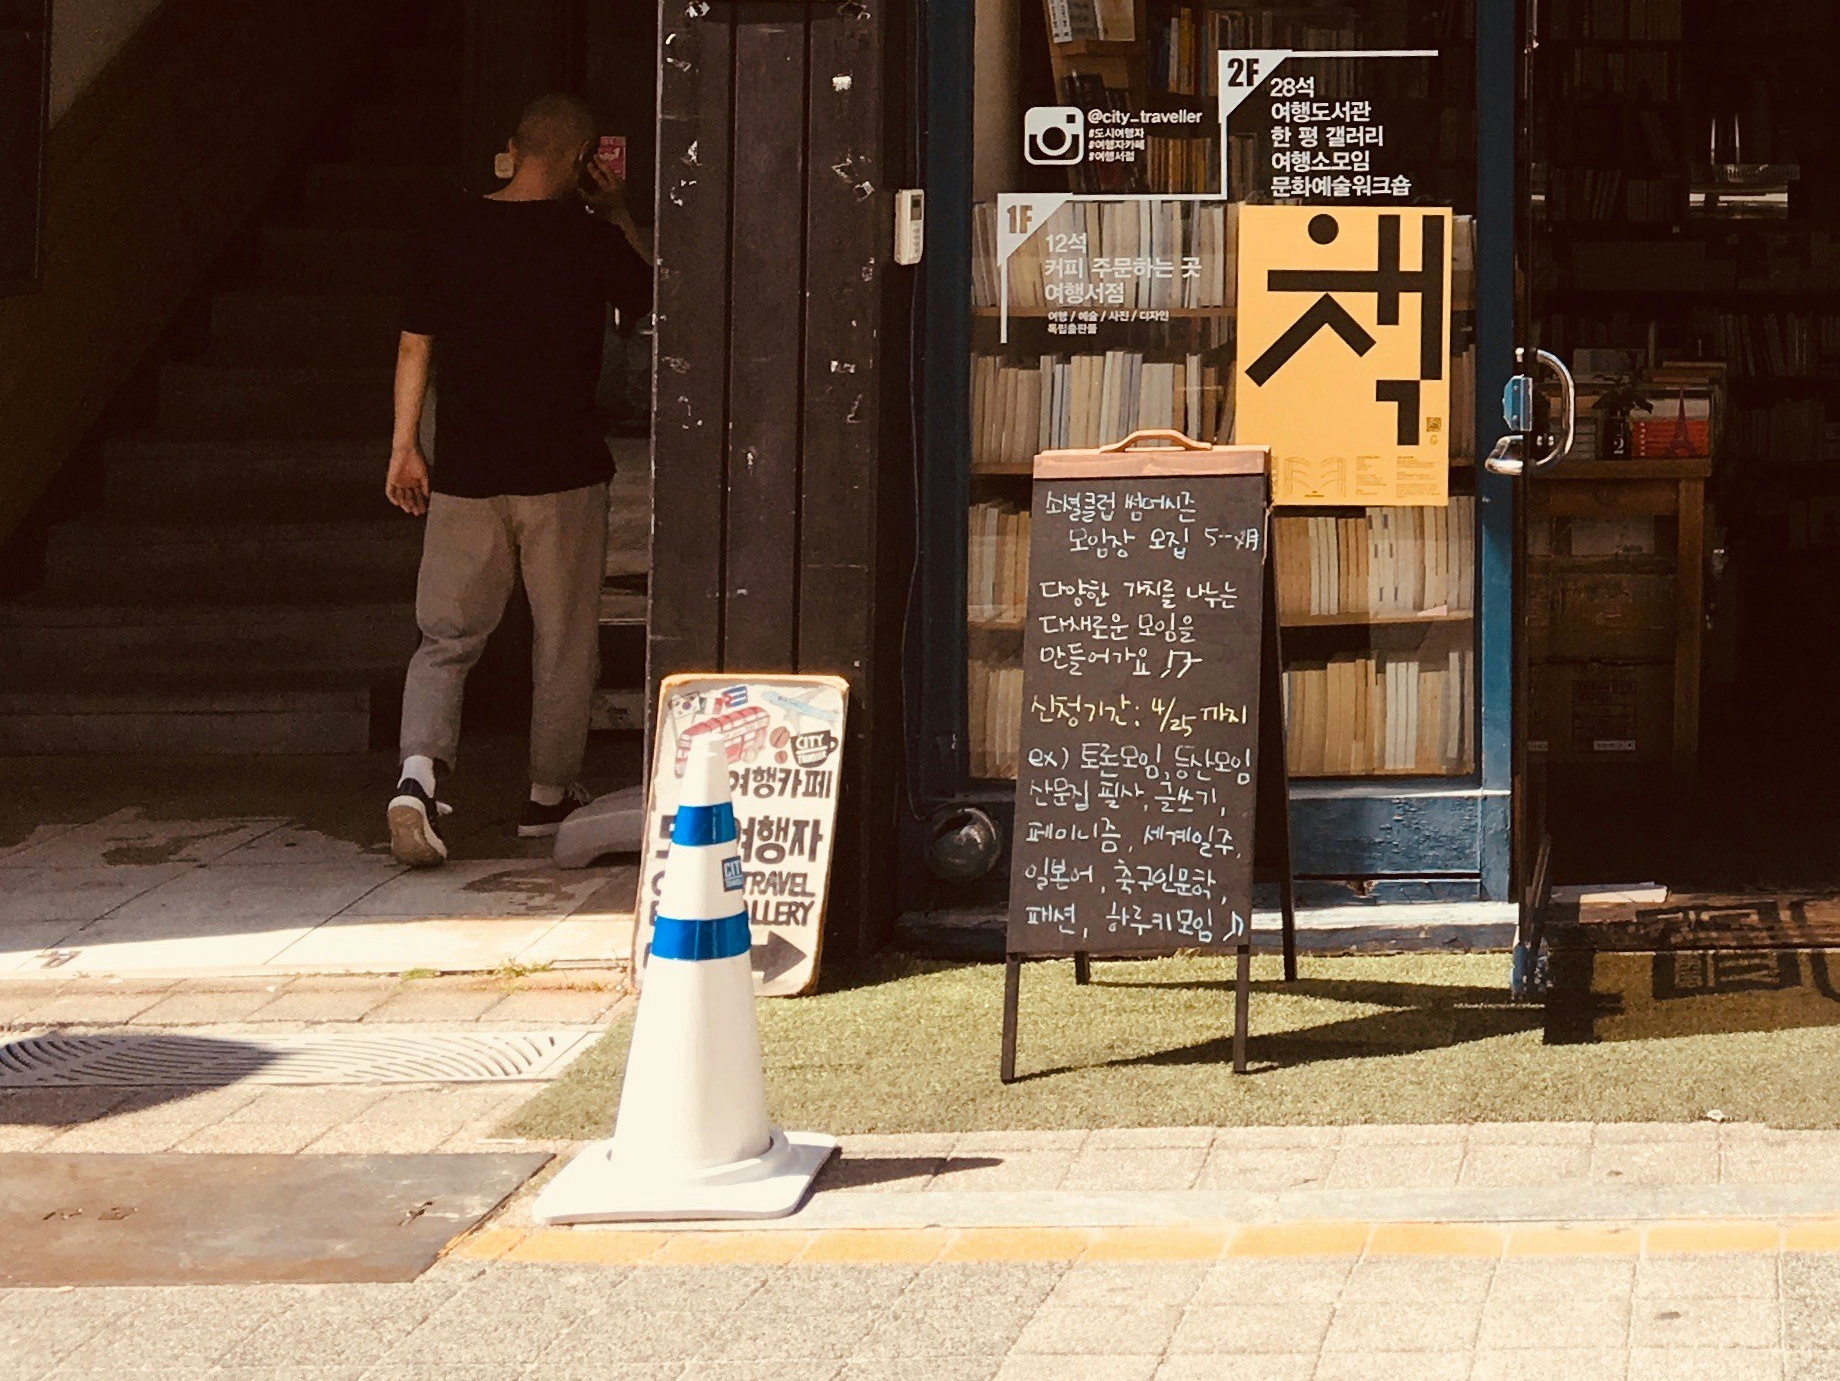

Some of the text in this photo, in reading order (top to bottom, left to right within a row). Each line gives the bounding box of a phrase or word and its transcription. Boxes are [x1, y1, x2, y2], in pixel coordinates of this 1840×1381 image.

[1227, 58, 1259, 87] 2F
[1270, 76, 1315, 98] 28석
[1088, 109, 1202, 125] @city_traveller
[1271, 100, 1371, 123] 여행도서관
[1270, 125, 1383, 148] 한 평 갤러리
[1271, 150, 1370, 172] 여행소모임
[1271, 174, 1412, 198] 문화예술워크숍
[1007, 204, 1033, 234] 1F
[1045, 232, 1088, 254] 12석
[1044, 256, 1202, 279] 커피 주문하는 곳
[1045, 281, 1125, 305] 여행서점
[1039, 578, 1238, 609] 다양한 가치를 나누는
[1039, 613, 1196, 643] 다채로운 모임을
[1040, 643, 1151, 676] 만들어가요
[1200, 702, 1247, 724] 까지
[1175, 745, 1251, 785] 등산모임
[1030, 777, 1089, 811] 산문집
